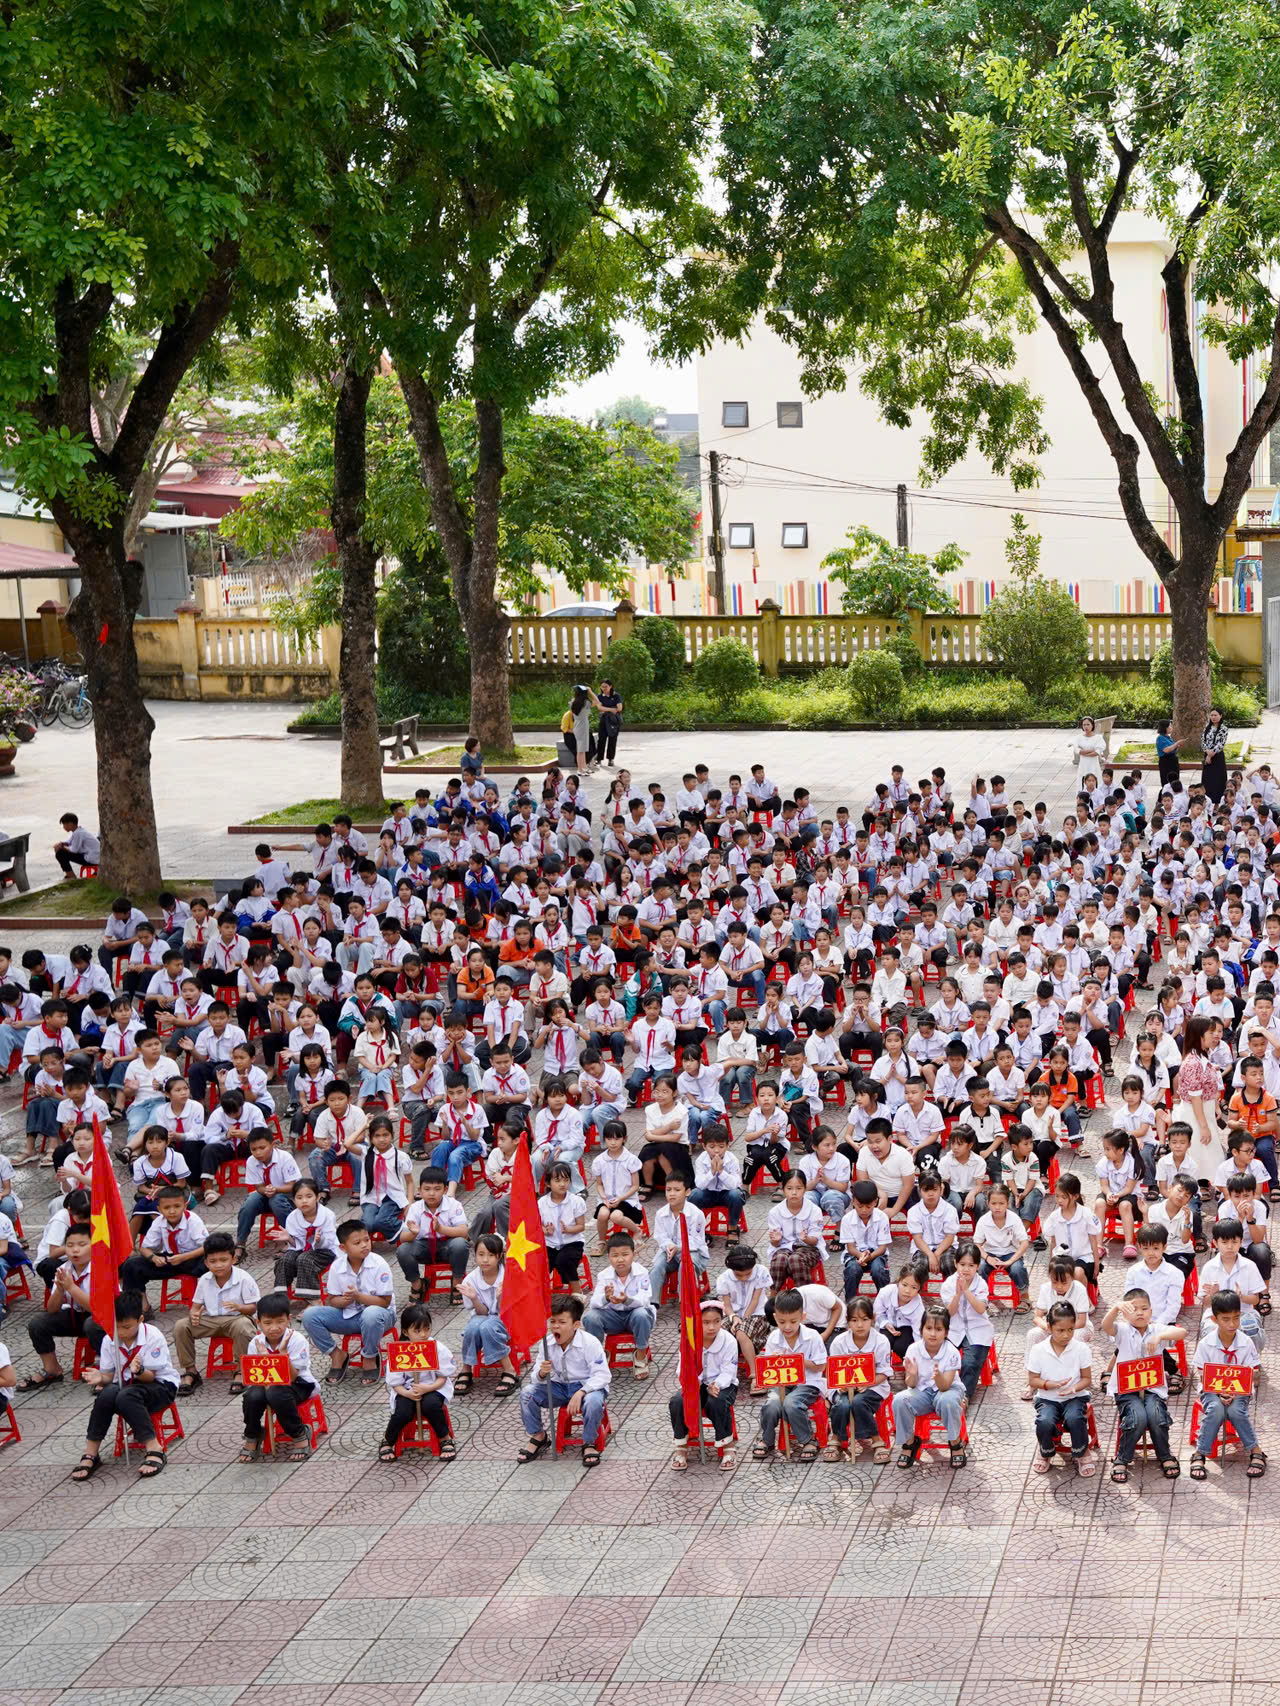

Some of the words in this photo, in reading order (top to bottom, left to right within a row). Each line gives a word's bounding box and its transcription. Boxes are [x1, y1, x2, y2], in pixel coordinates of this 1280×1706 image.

[395, 1352, 432, 1369] 2A
[249, 1367, 284, 1383] 3A
[763, 1367, 799, 1385] 2B
[834, 1367, 870, 1386] 1A
[1124, 1369, 1158, 1390] 1B
[1208, 1377, 1246, 1393] 4A
